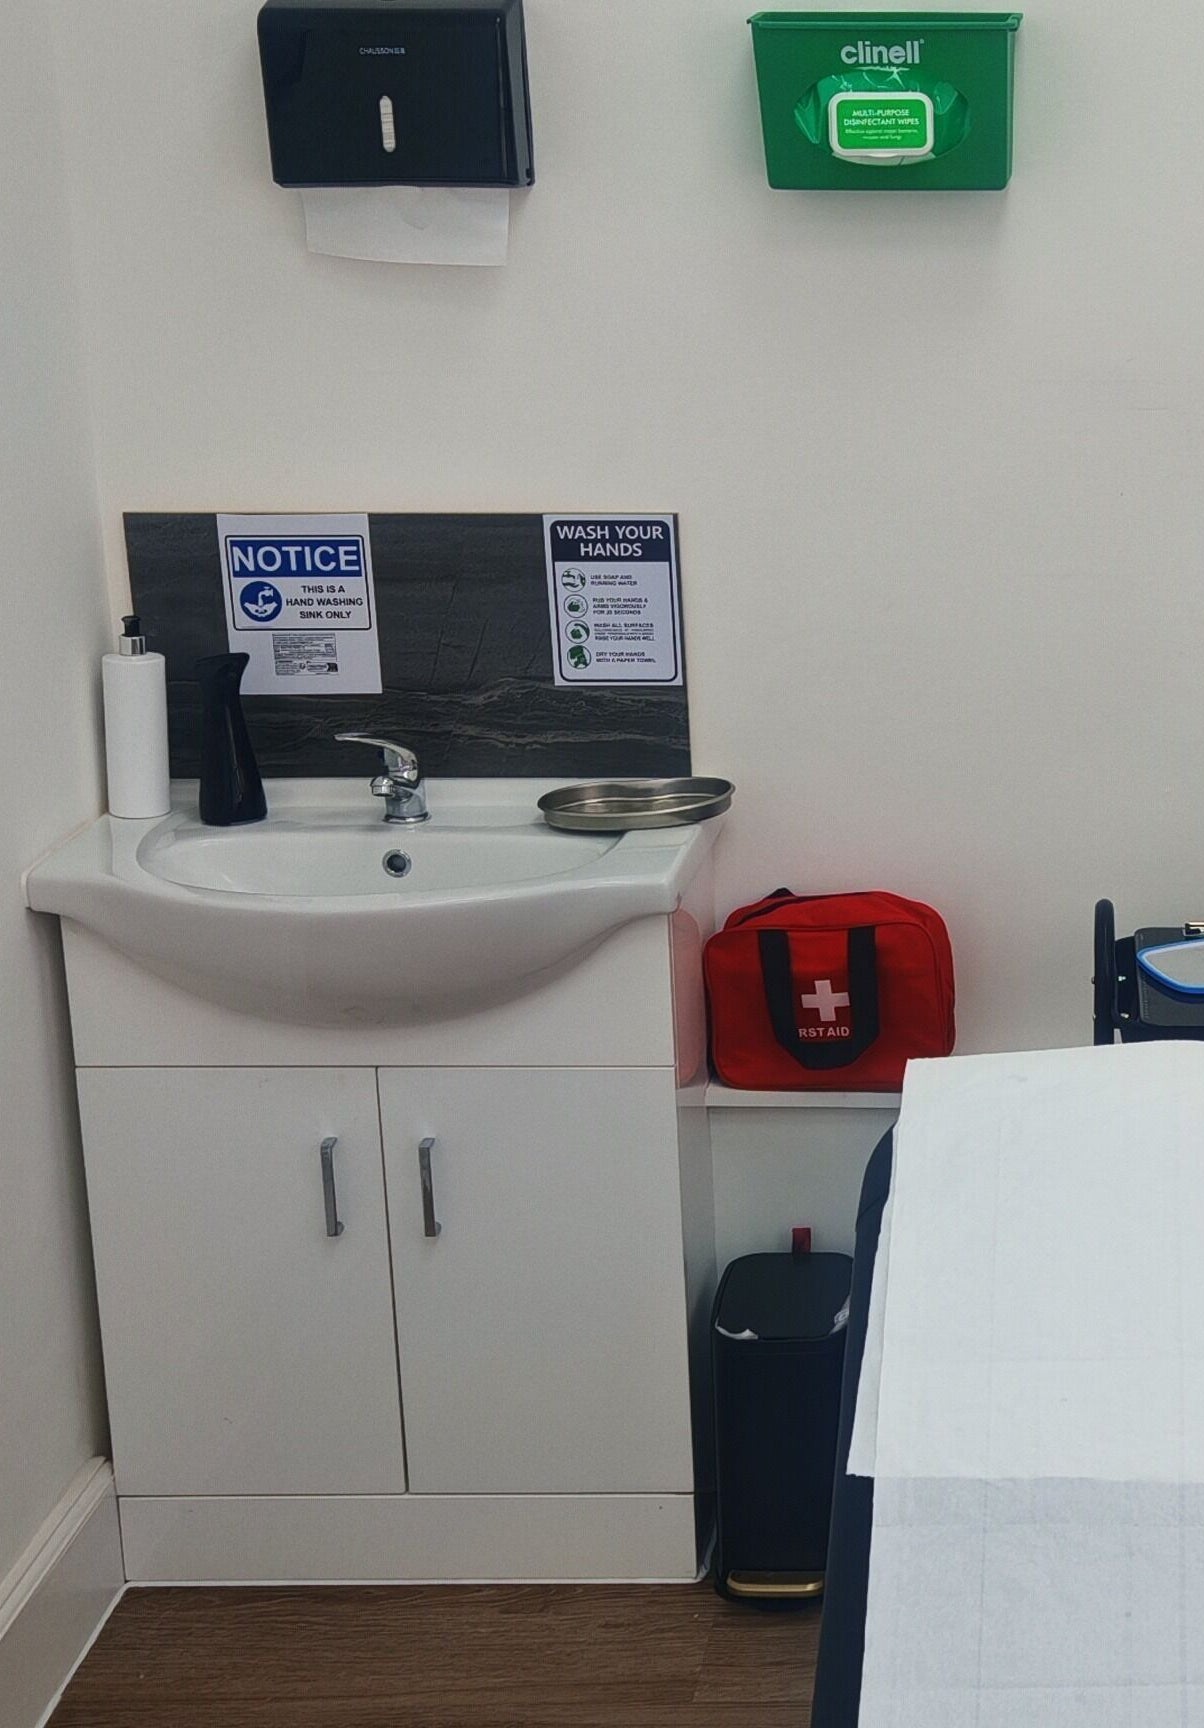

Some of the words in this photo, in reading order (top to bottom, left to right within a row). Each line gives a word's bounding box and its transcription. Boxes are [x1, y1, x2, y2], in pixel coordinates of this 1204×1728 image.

[840, 40, 920, 64] clinell
[852, 109, 910, 117] MULTI-PURPOSE
[843, 118, 896, 126] DISINFECTANT
[556, 525, 609, 540] WASH
[615, 525, 664, 540] YOUR
[580, 543, 643, 557] HANDS
[232, 546, 360, 572] NOTICE
[301, 585, 324, 593] THIS
[326, 585, 336, 593] IS
[338, 585, 345, 593] A
[286, 598, 314, 606] HAND
[316, 598, 363, 606] WASHING
[300, 611, 323, 619] SINK
[326, 611, 352, 619] ONLY
[798, 1028, 826, 1038] RST
[826, 1026, 850, 1037] AID
